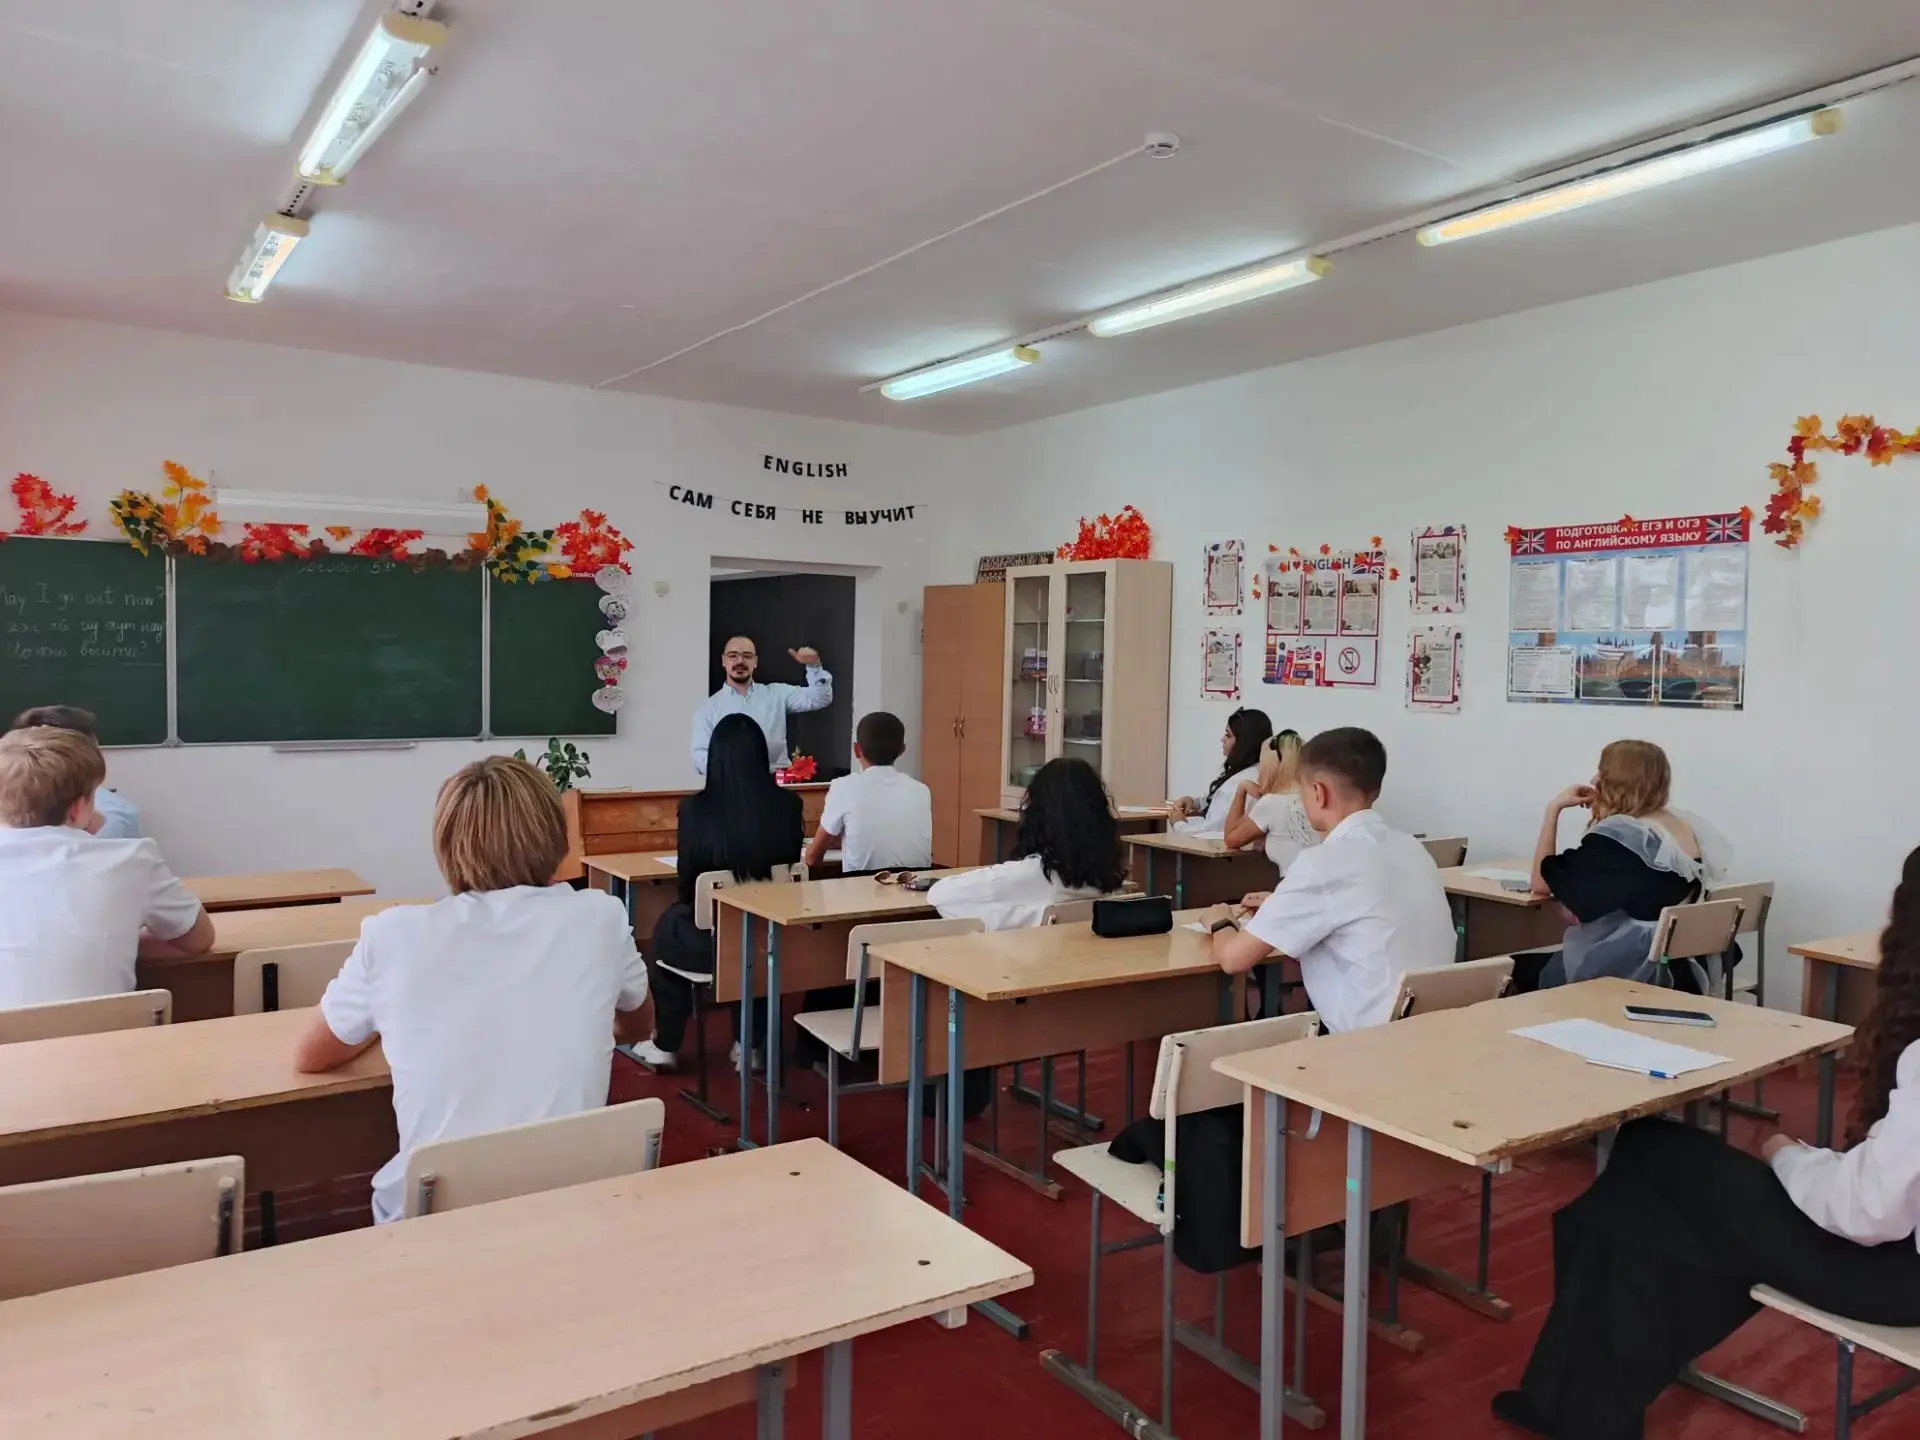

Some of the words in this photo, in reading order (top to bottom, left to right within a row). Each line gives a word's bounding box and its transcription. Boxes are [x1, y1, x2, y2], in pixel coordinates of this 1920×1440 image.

[763, 454, 848, 478] ENGLISH
[668, 485, 713, 510] САМ
[730, 500, 776, 521] СЕБЯ
[802, 509, 824, 525] НЕ
[844, 505, 916, 526] ВЫУЧИТ
[1641, 520, 1662, 532] ЕГЭ
[1665, 519, 1674, 529] И
[1677, 517, 1701, 529] ОГЭ
[1555, 539, 1571, 551] ПО
[1573, 533, 1656, 550] АНГЛИЙСКОМУ
[1660, 530, 1702, 544] ЯЗЫКУ
[35, 581, 51, 604] I
